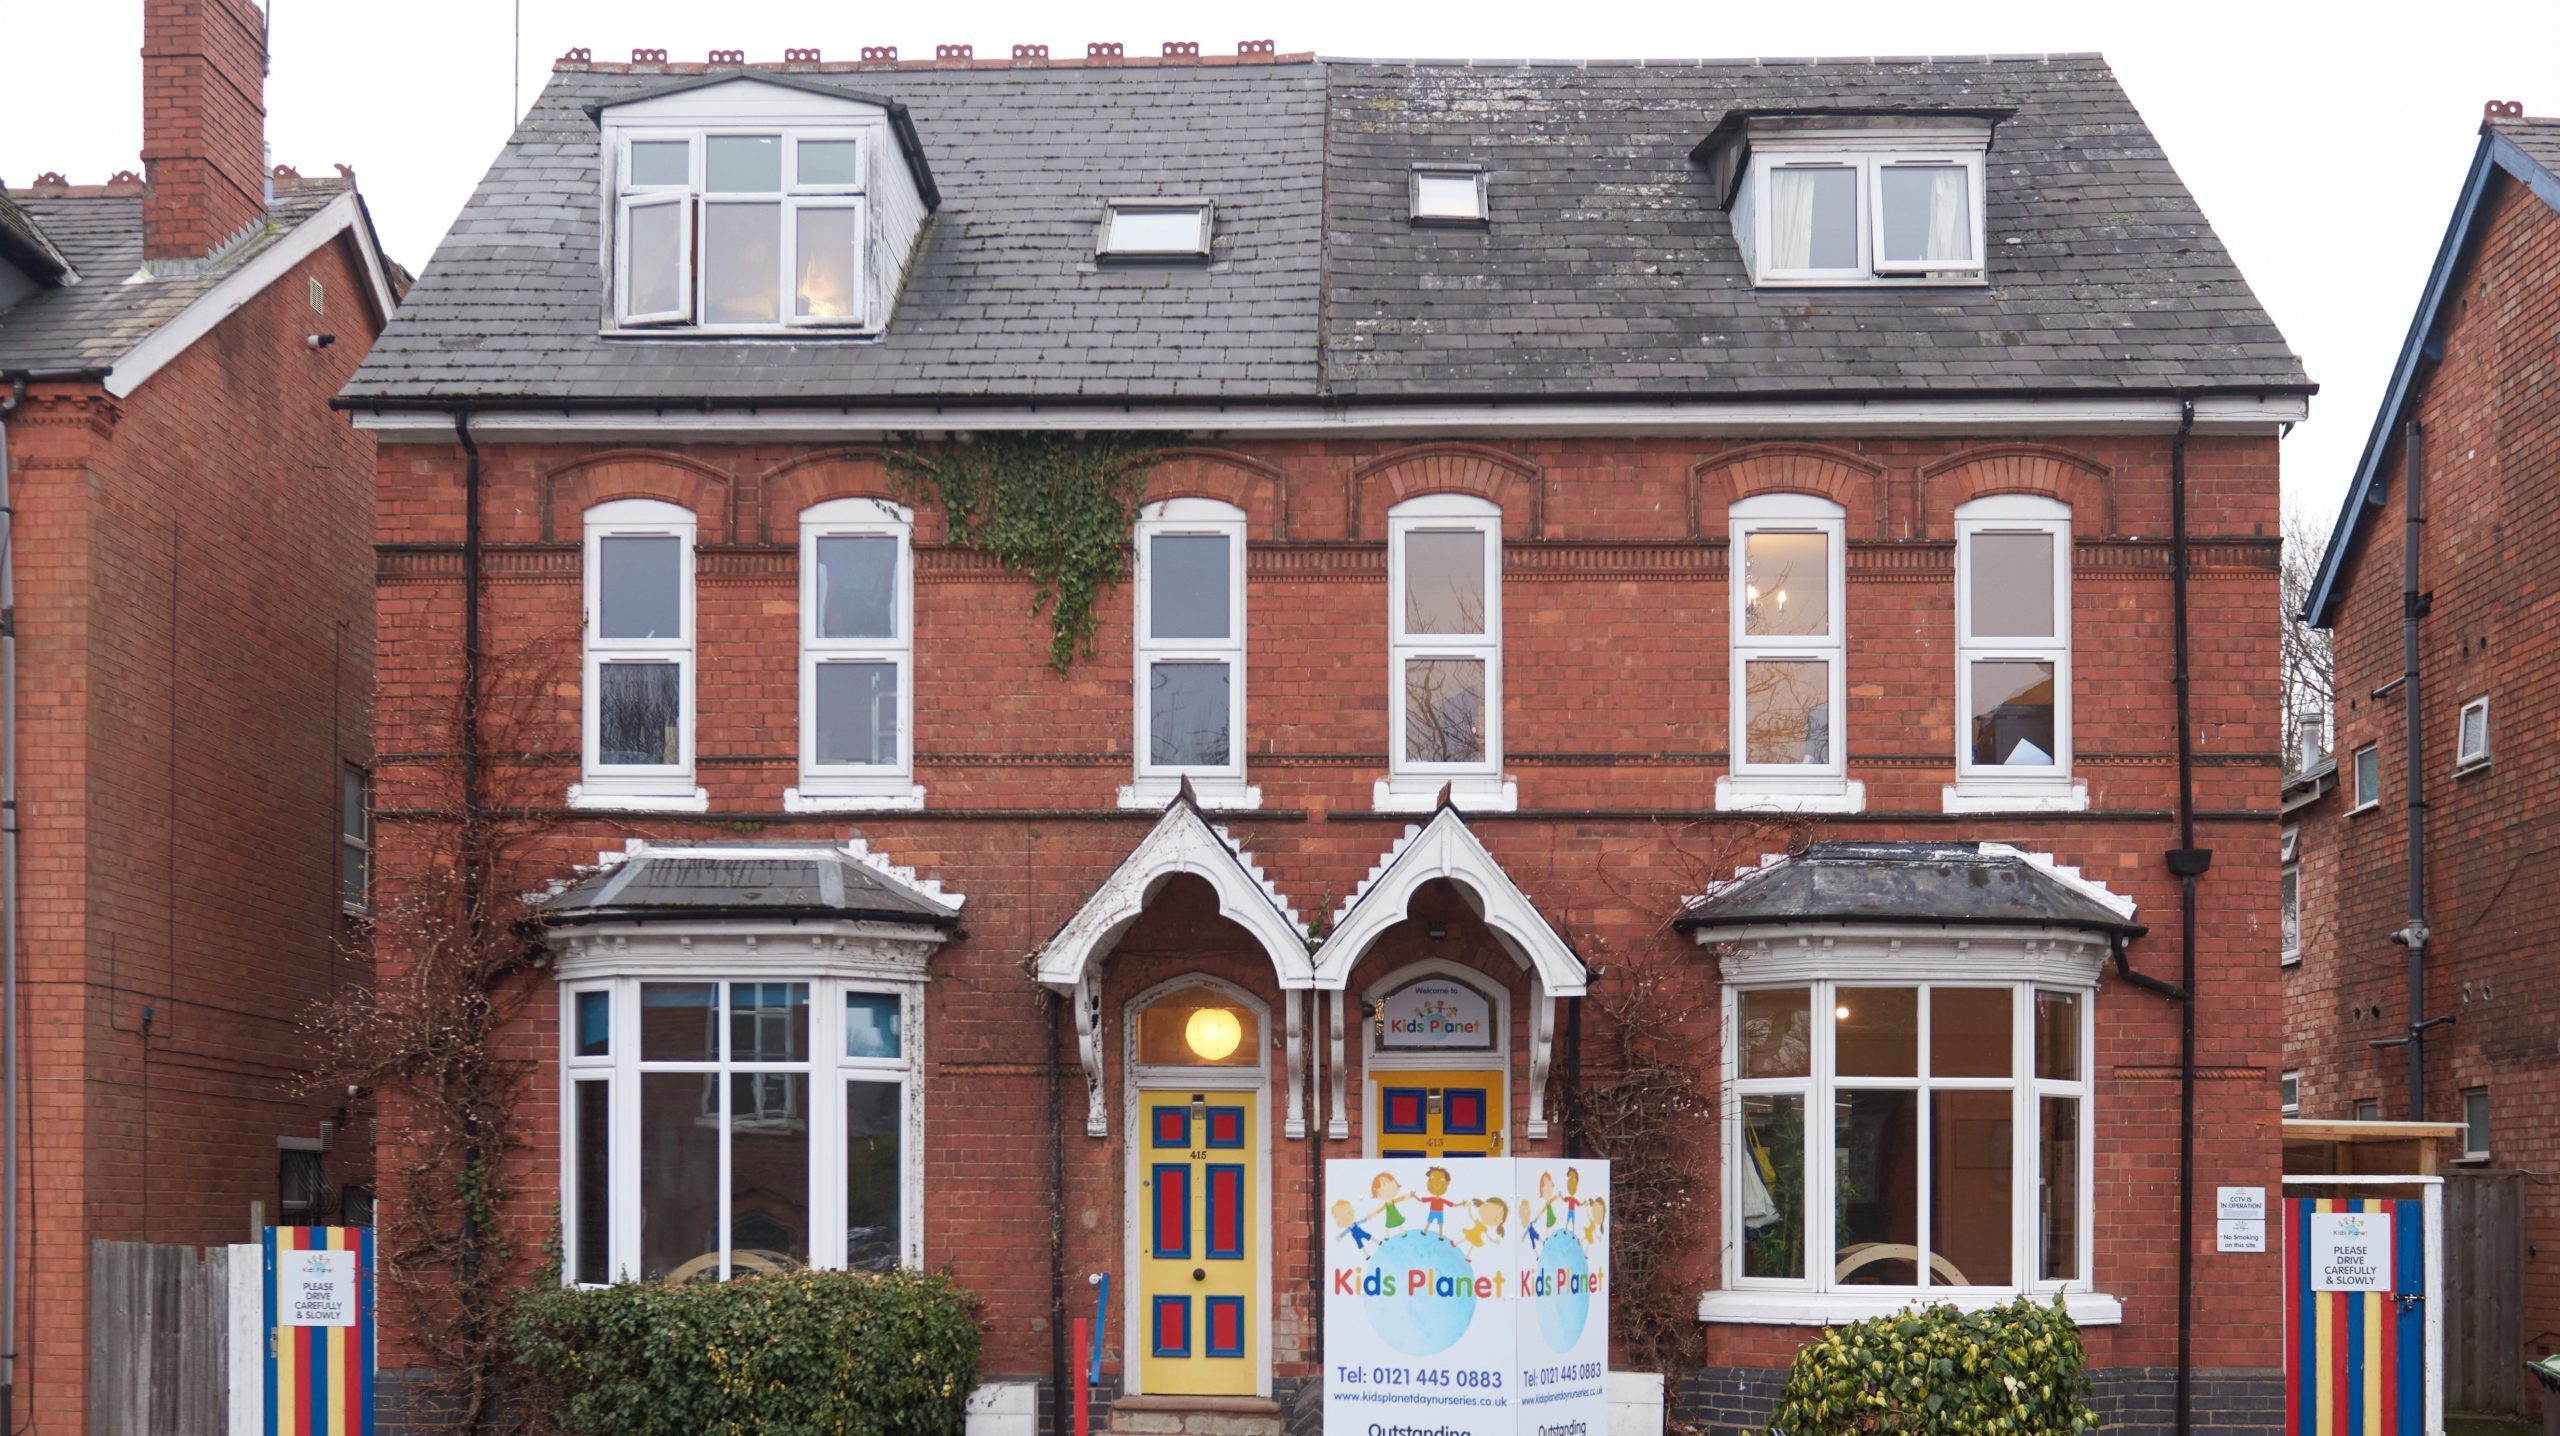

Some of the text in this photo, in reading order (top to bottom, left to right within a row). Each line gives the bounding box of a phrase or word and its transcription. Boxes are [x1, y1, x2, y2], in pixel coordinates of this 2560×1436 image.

[1391, 1019, 1480, 1033] Kids Planet
[1190, 1151, 1207, 1159] 415
[2333, 1246, 2368, 1255] PLEASE
[2336, 1256, 2365, 1265] DRIVE
[2324, 1266, 2377, 1275] CAREFULLY
[1334, 1267, 1506, 1298] Kids Planet
[1521, 1267, 1604, 1297] Kids Planet
[2325, 1276, 2376, 1285] & SLOWLY
[303, 1282, 334, 1291] PLEASE
[306, 1292, 331, 1301] DRIVE
[295, 1301, 342, 1310] CAREFULLY
[296, 1311, 341, 1320] & SLOWLY
[1337, 1366, 1502, 1388] Tel: 0121 445 0883
[1523, 1362, 1601, 1387] Tel: 0121 445 0883
[1334, 1392, 1508, 1407] www.kidsplanetdaynurseries.co.uk
[1538, 1419, 1587, 1436] Outstanding
